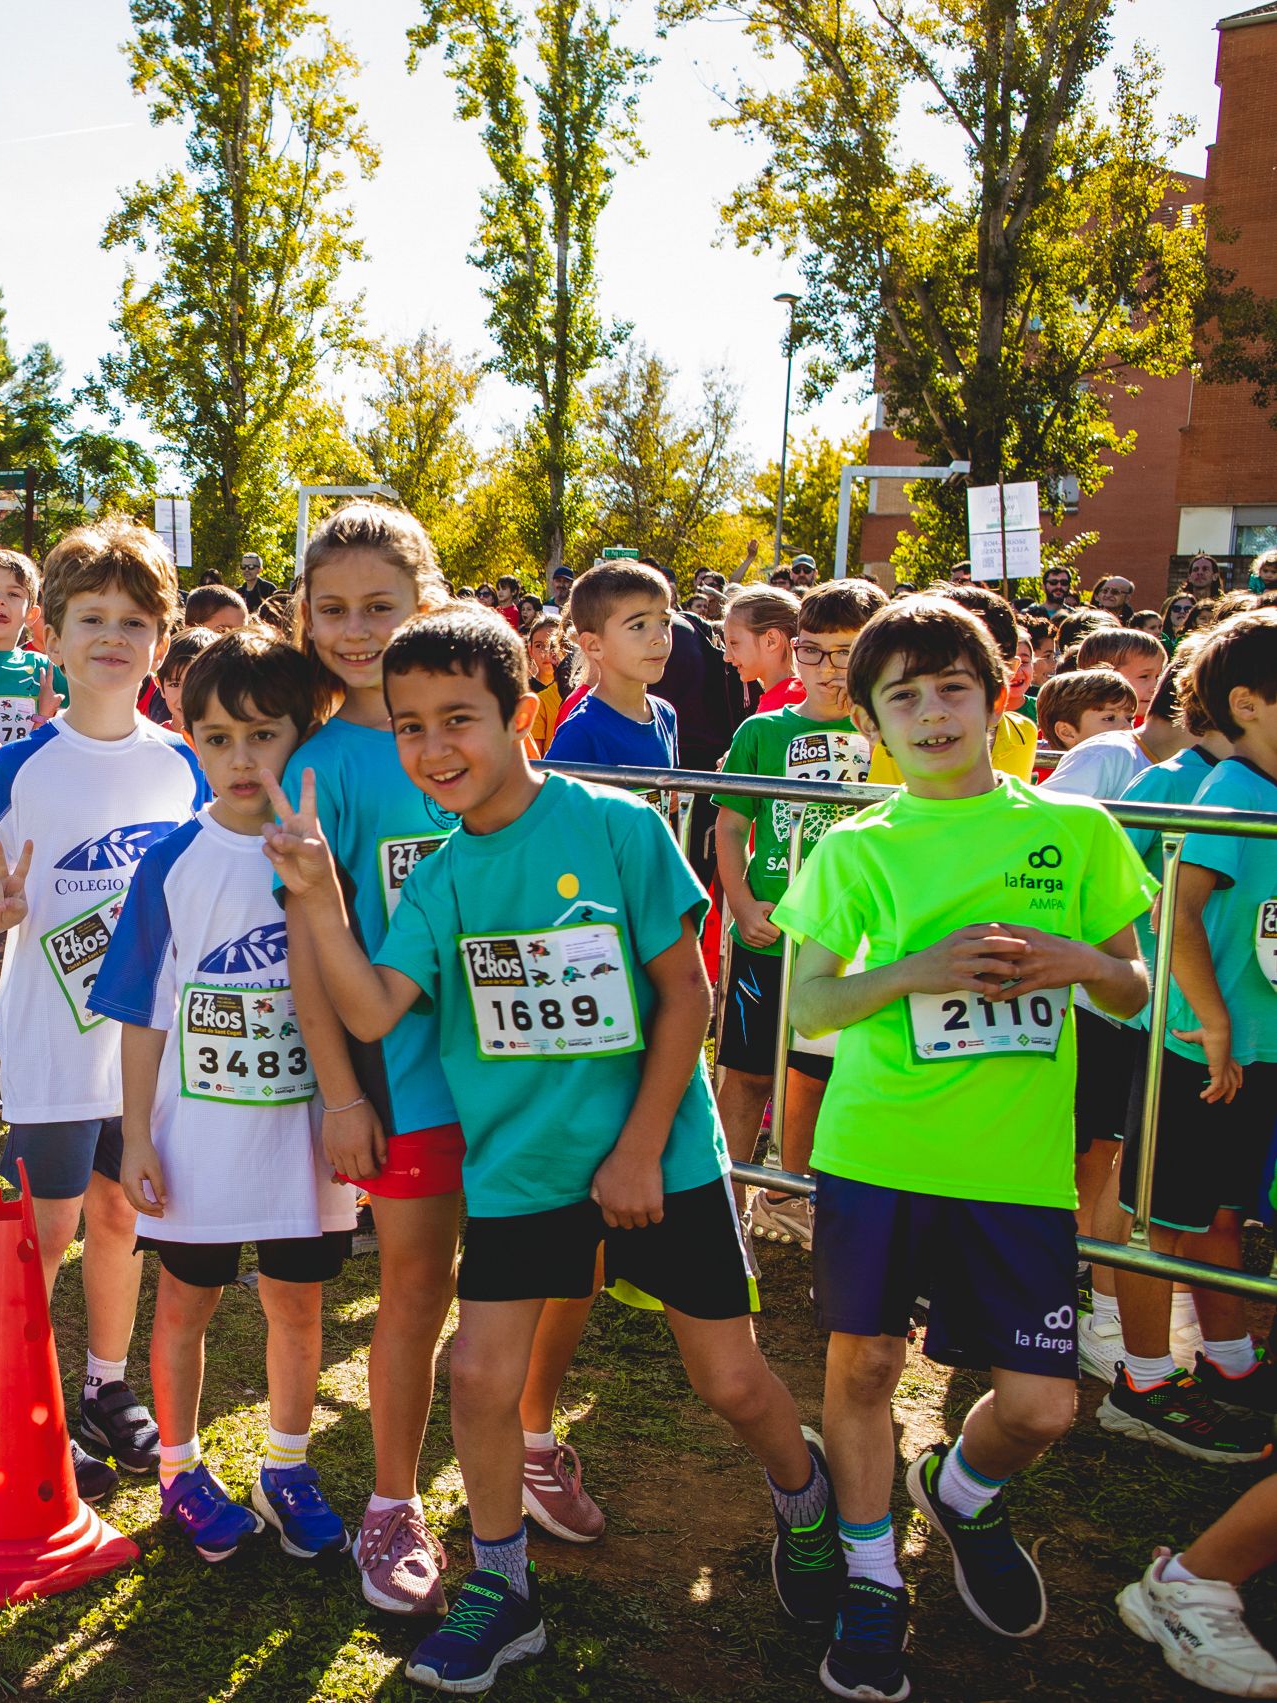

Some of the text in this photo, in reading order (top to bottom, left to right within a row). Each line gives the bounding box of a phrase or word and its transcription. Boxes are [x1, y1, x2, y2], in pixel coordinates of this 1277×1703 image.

[791, 745, 827, 762] CROS
[55, 878, 124, 896] COLEGIO
[1029, 898, 1065, 910] AMPA
[61, 929, 109, 965] CROS
[473, 957, 523, 979] CROS
[191, 1009, 243, 1030] CROS
[491, 995, 599, 1031] 1689
[941, 995, 1053, 1031] 2110
[199, 1046, 307, 1079] 3483
[1015, 1329, 1073, 1353] la farga
[849, 1583, 899, 1602] SKECHERS
